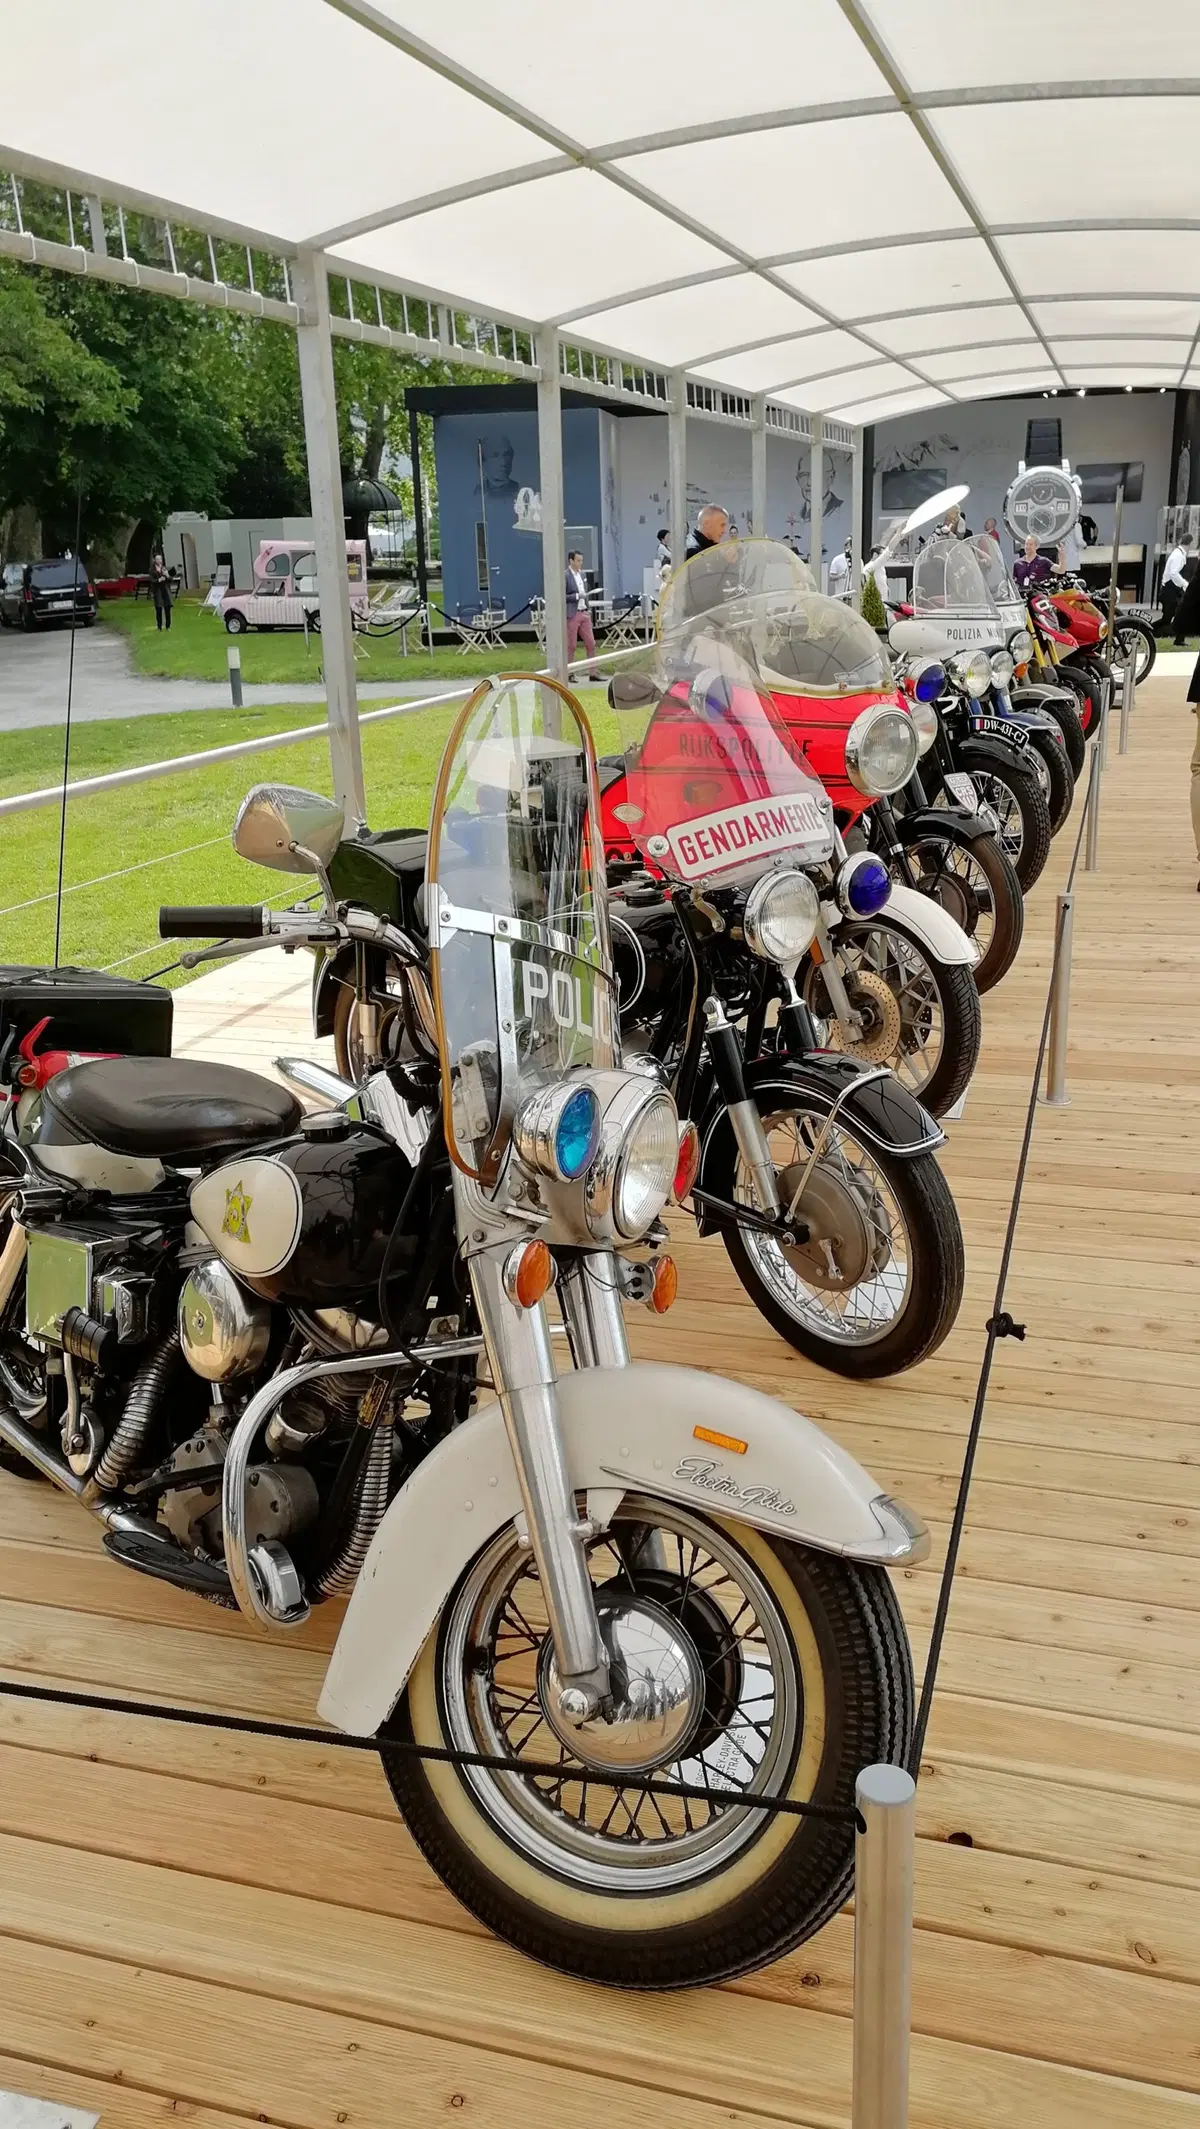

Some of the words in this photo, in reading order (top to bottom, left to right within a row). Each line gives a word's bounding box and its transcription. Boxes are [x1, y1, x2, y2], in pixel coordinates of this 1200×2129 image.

[946, 627, 983, 641] POLIZIA
[983, 719, 1026, 744] DW-431-CJ
[956, 785, 974, 797] CRS
[677, 801, 824, 866] GENDARMERIE
[521, 960, 612, 1048] POLIC
[671, 1454, 742, 1499] Electra
[720, 1757, 740, 1792] ELCTRA
